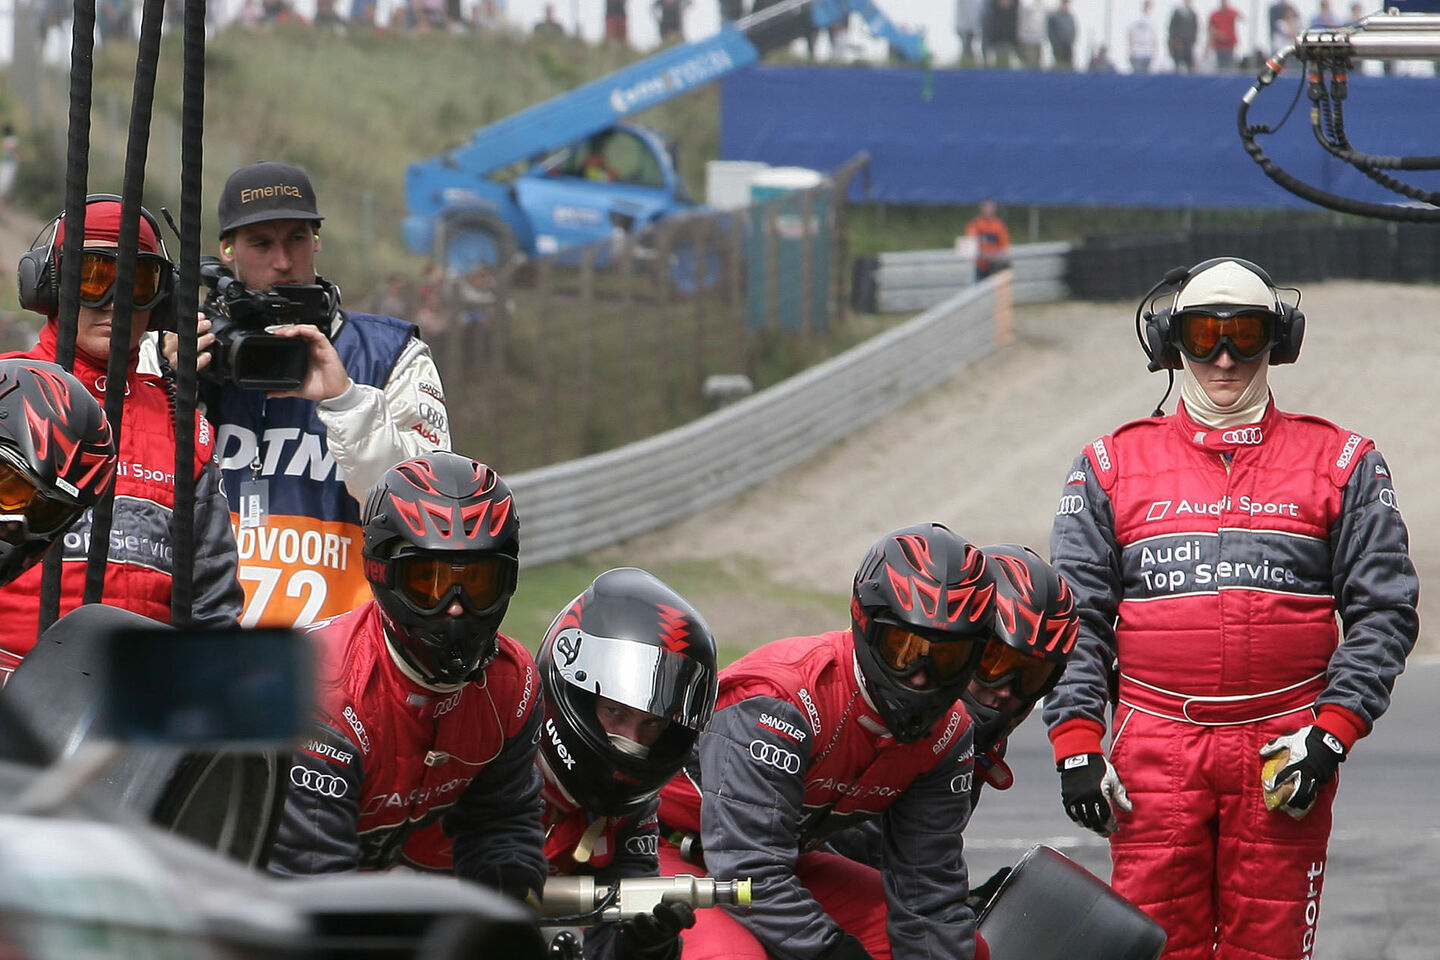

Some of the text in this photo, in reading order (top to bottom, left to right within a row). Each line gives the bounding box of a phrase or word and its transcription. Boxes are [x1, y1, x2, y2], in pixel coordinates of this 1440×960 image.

[411, 423, 441, 446] Audi
[216, 424, 345, 481] DTM
[1336, 434, 1362, 470] sparco
[1175, 495, 1299, 516] Audi Sport
[110, 530, 173, 560] Servic
[1141, 540, 1200, 567] Audi
[1141, 559, 1295, 592] Top Service
[239, 565, 328, 629] 72
[759, 713, 807, 743] SANDTLER
[797, 688, 822, 736] sparco
[545, 717, 576, 770] uvex
[932, 711, 962, 755] sparco
[304, 739, 354, 765] ANDTLER
